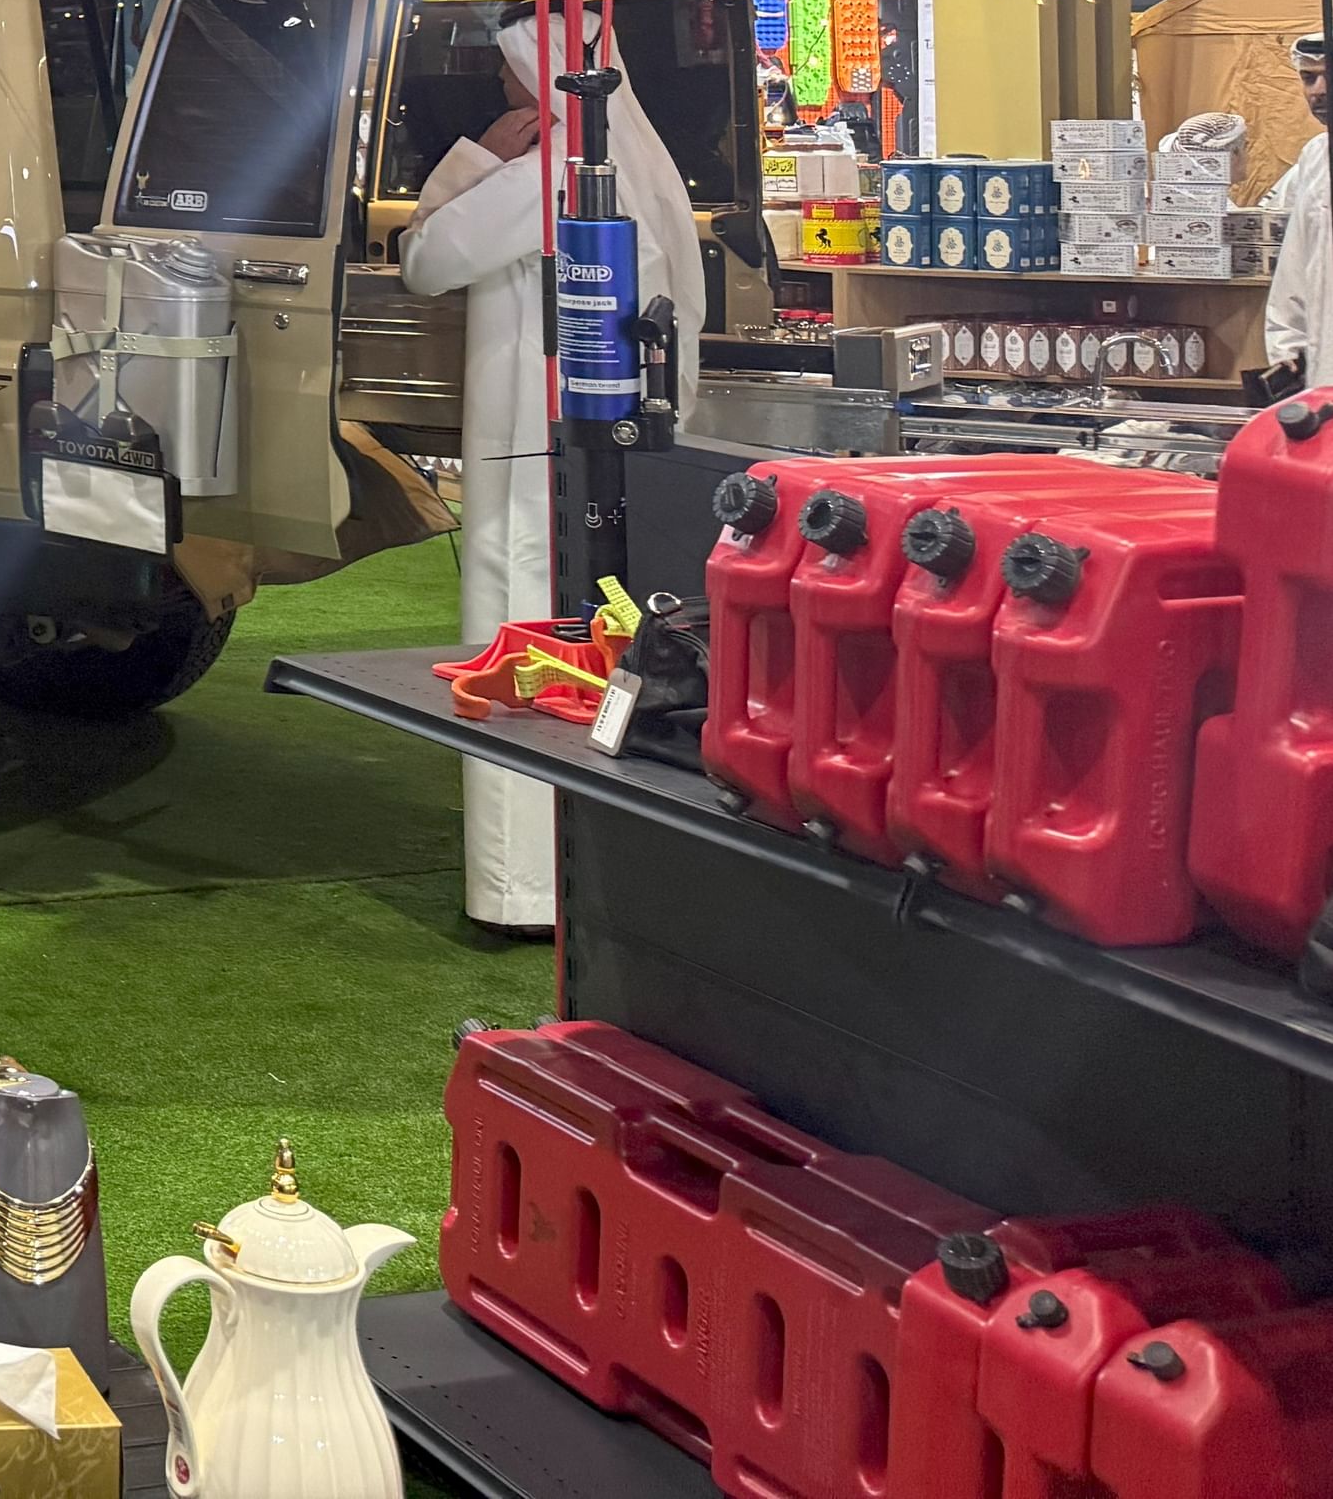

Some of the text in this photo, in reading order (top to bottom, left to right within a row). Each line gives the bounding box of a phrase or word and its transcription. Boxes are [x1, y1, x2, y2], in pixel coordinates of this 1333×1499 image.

[571, 267, 610, 281] PMP
[56, 440, 116, 461] TOYOTA
[120, 451, 154, 468] 4WD
